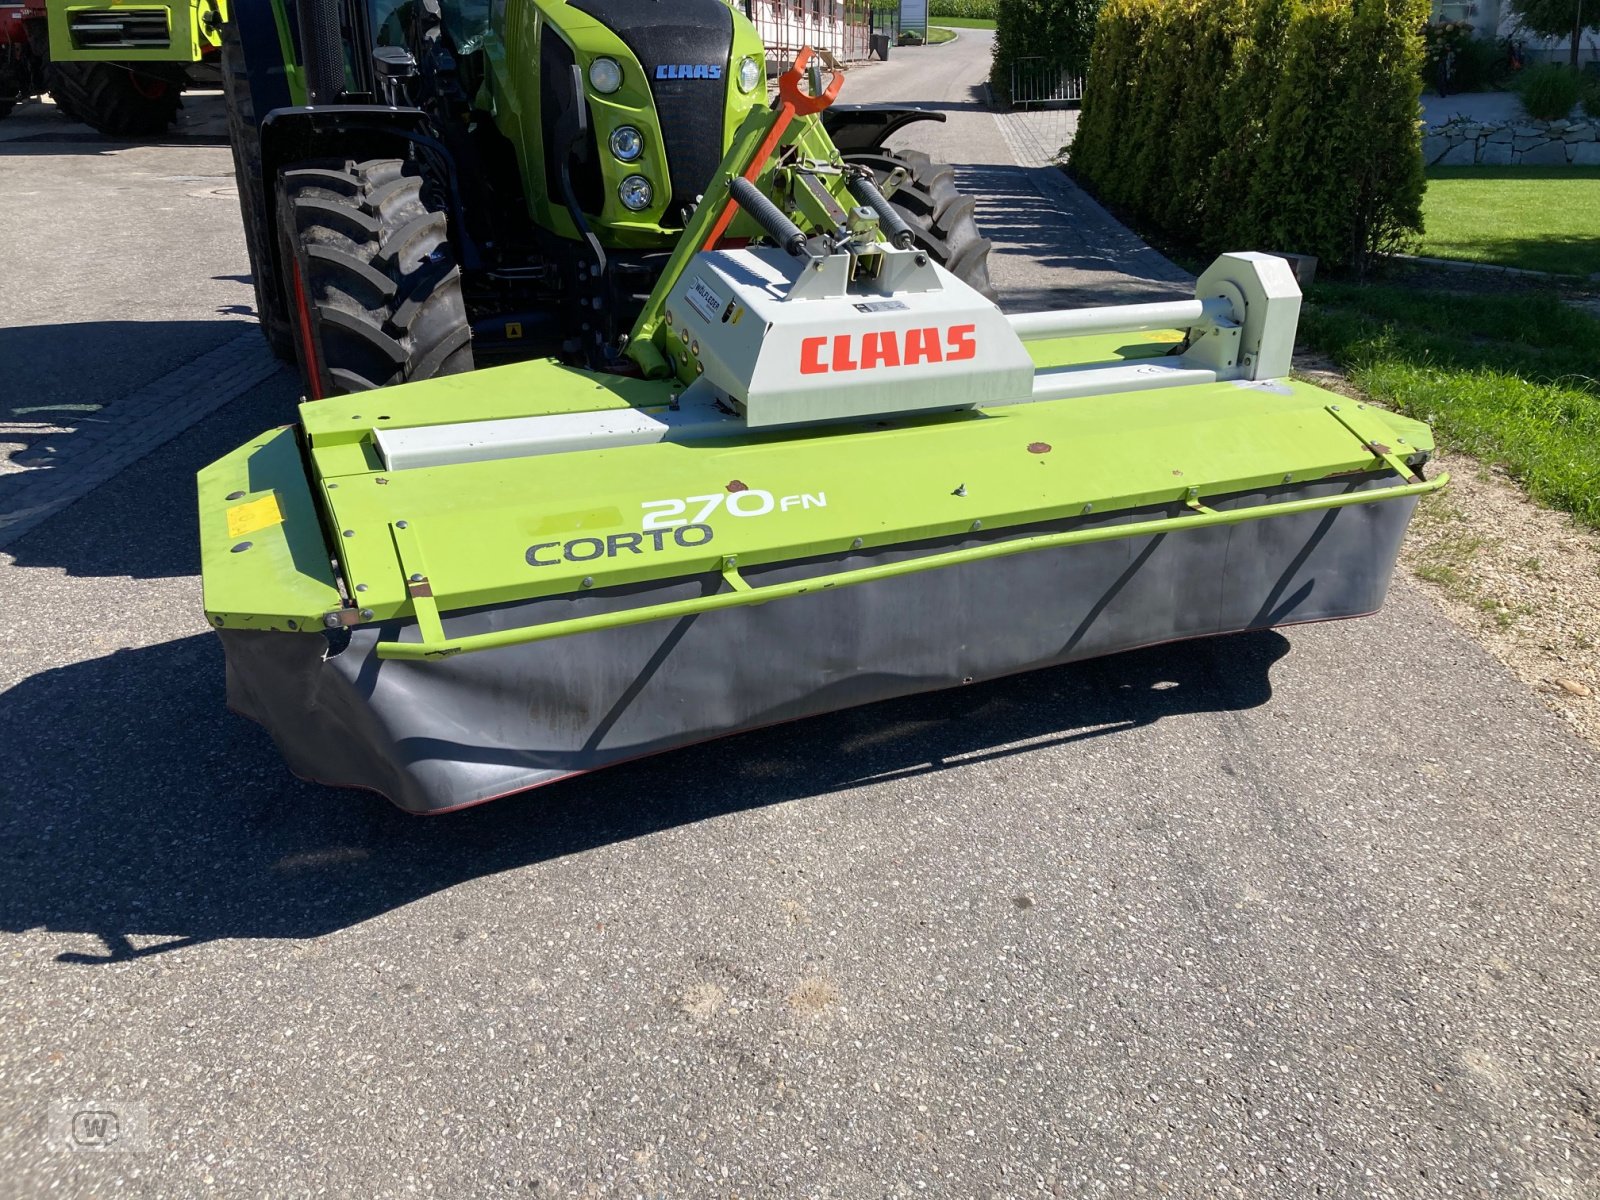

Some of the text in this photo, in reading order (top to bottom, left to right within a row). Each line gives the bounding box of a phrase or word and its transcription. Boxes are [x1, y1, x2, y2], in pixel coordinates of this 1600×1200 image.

[655, 64, 721, 79] CLAAS
[800, 324, 976, 375] CLAAS
[641, 489, 827, 531] 270 FN
[525, 524, 714, 567] CORTO
